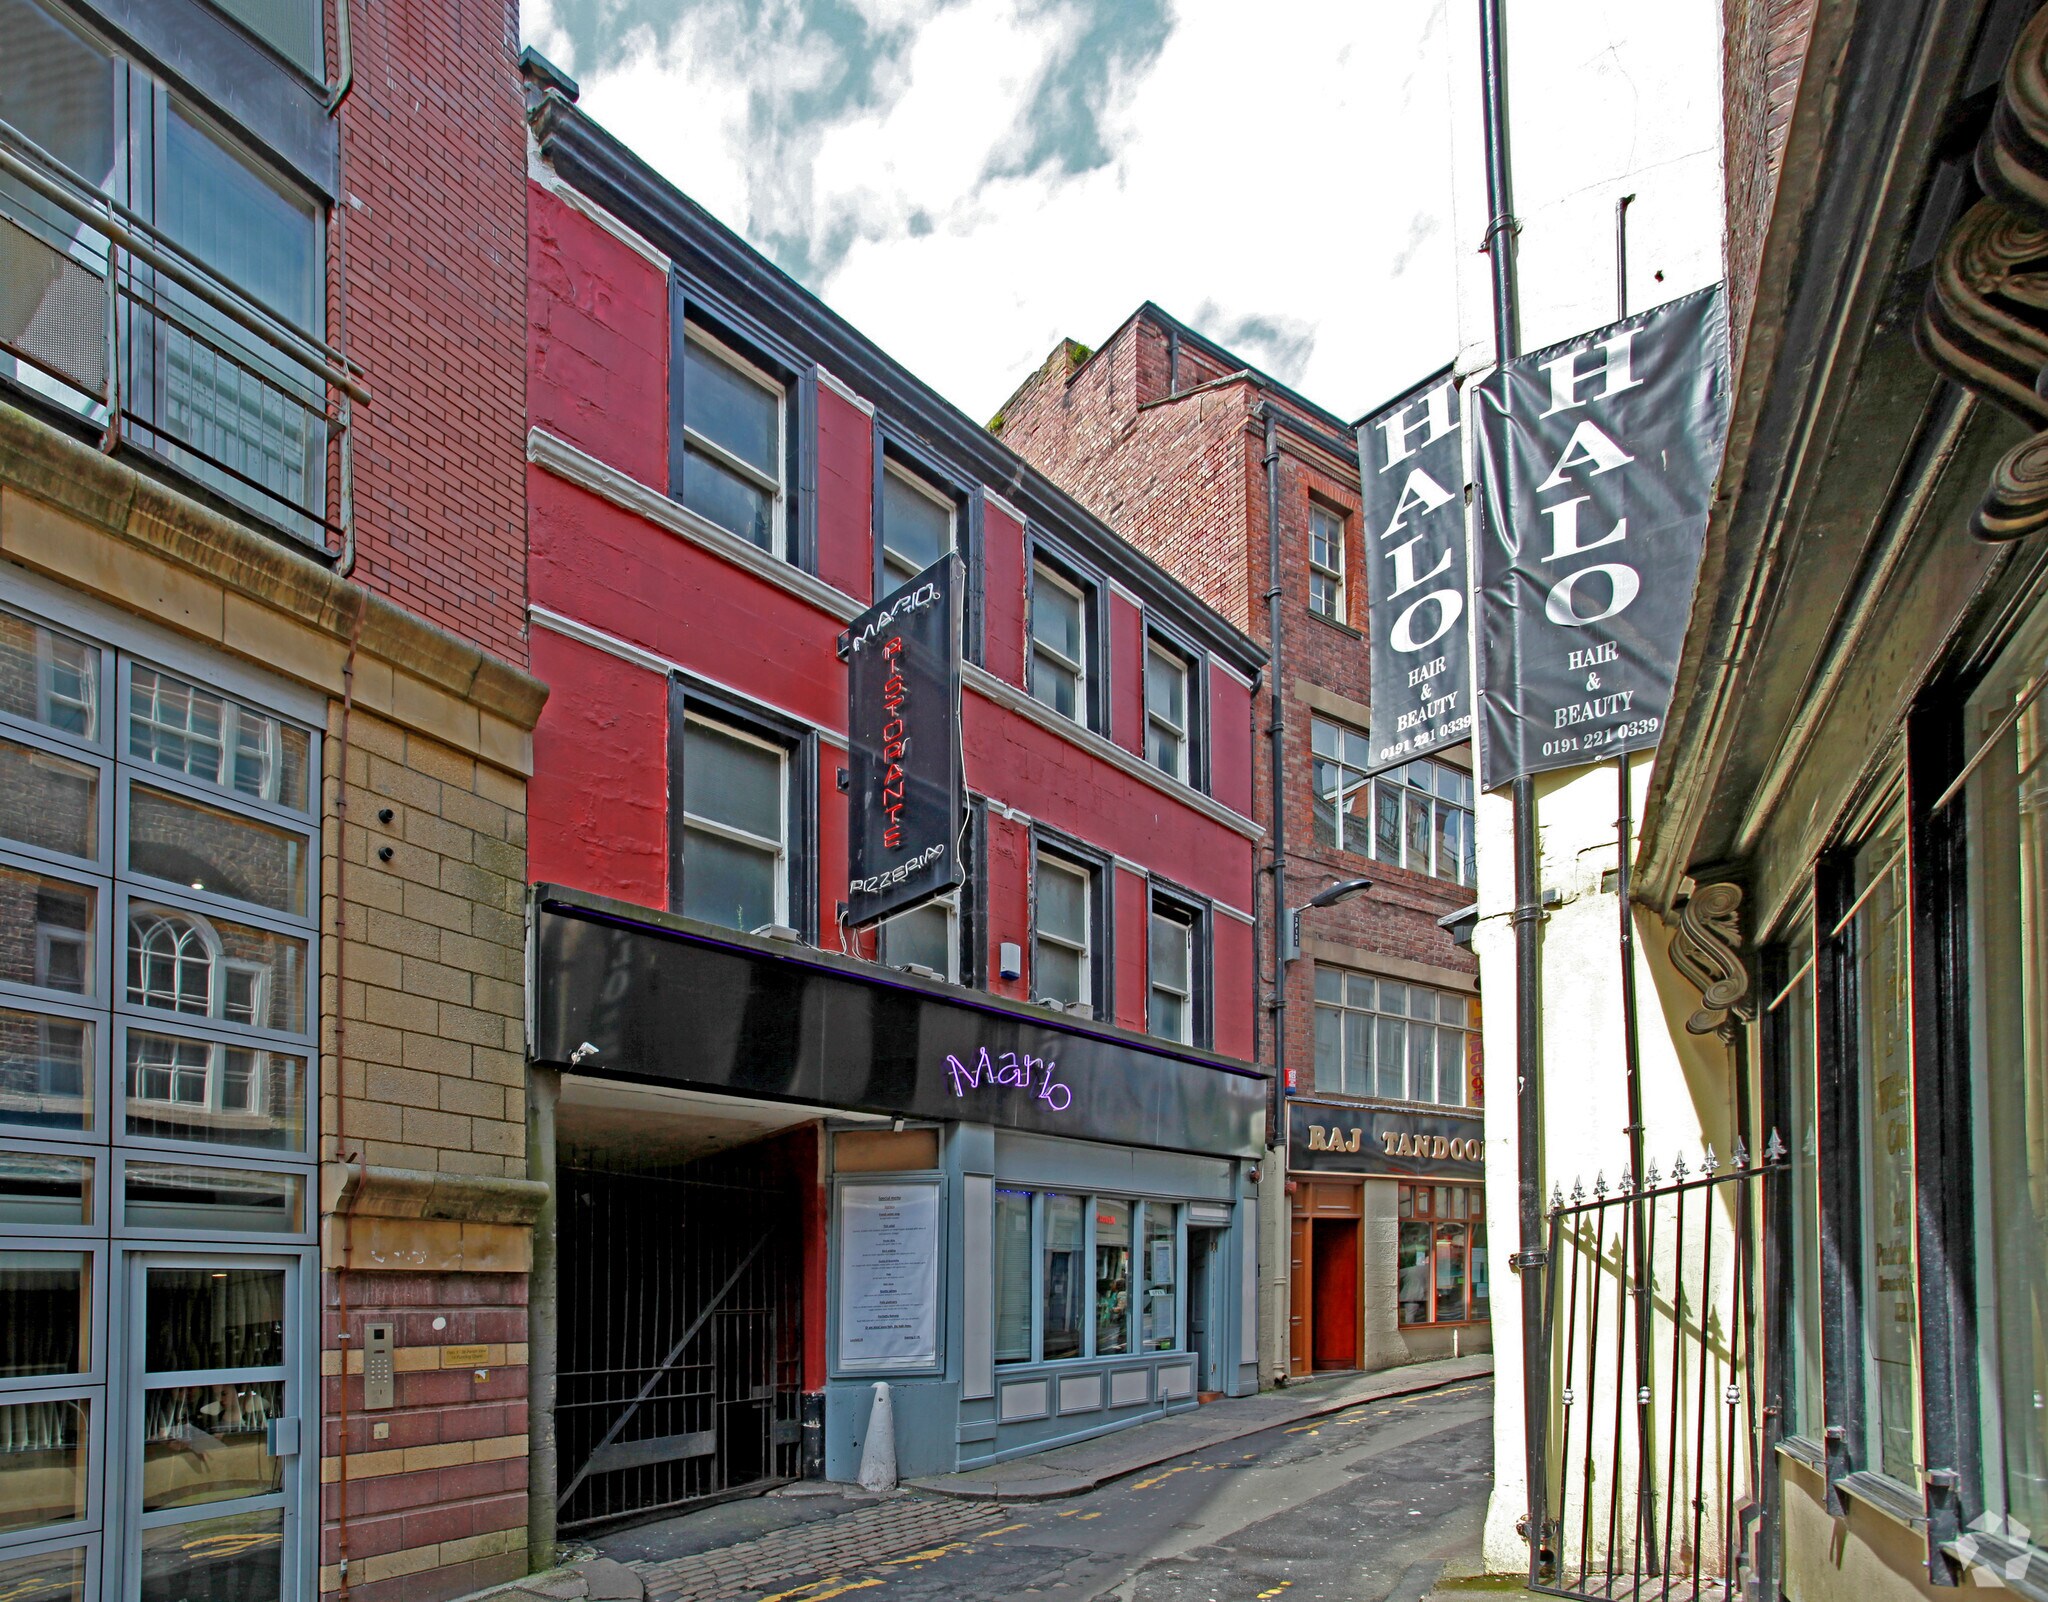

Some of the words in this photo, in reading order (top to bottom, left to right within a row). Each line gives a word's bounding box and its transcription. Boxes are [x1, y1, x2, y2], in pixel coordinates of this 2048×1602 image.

[1536, 326, 1645, 627] HALO
[1376, 382, 1463, 653] HALO
[853, 583, 940, 652] MARIO
[1407, 656, 1447, 688] HAIR
[1567, 640, 1619, 670] HAIR
[1420, 683, 1432, 701] &
[1585, 672, 1601, 691] &
[1396, 691, 1458, 733] BEAUTY
[1554, 690, 1635, 729] BEAUTY
[883, 637, 904, 848] RISTORANTE
[1380, 740, 1410, 760] 0191
[1413, 729, 1436, 749] 221
[1440, 714, 1472, 737] 0339
[1542, 736, 1579, 756] 0191
[1583, 726, 1613, 750] 221
[1617, 717, 1659, 739] 0339
[850, 844, 945, 894] PIZZERIA
[946, 1046, 1072, 1111] Mario
[1308, 1125, 1362, 1153] RAJ
[1382, 1131, 1484, 1162] TANDOO
